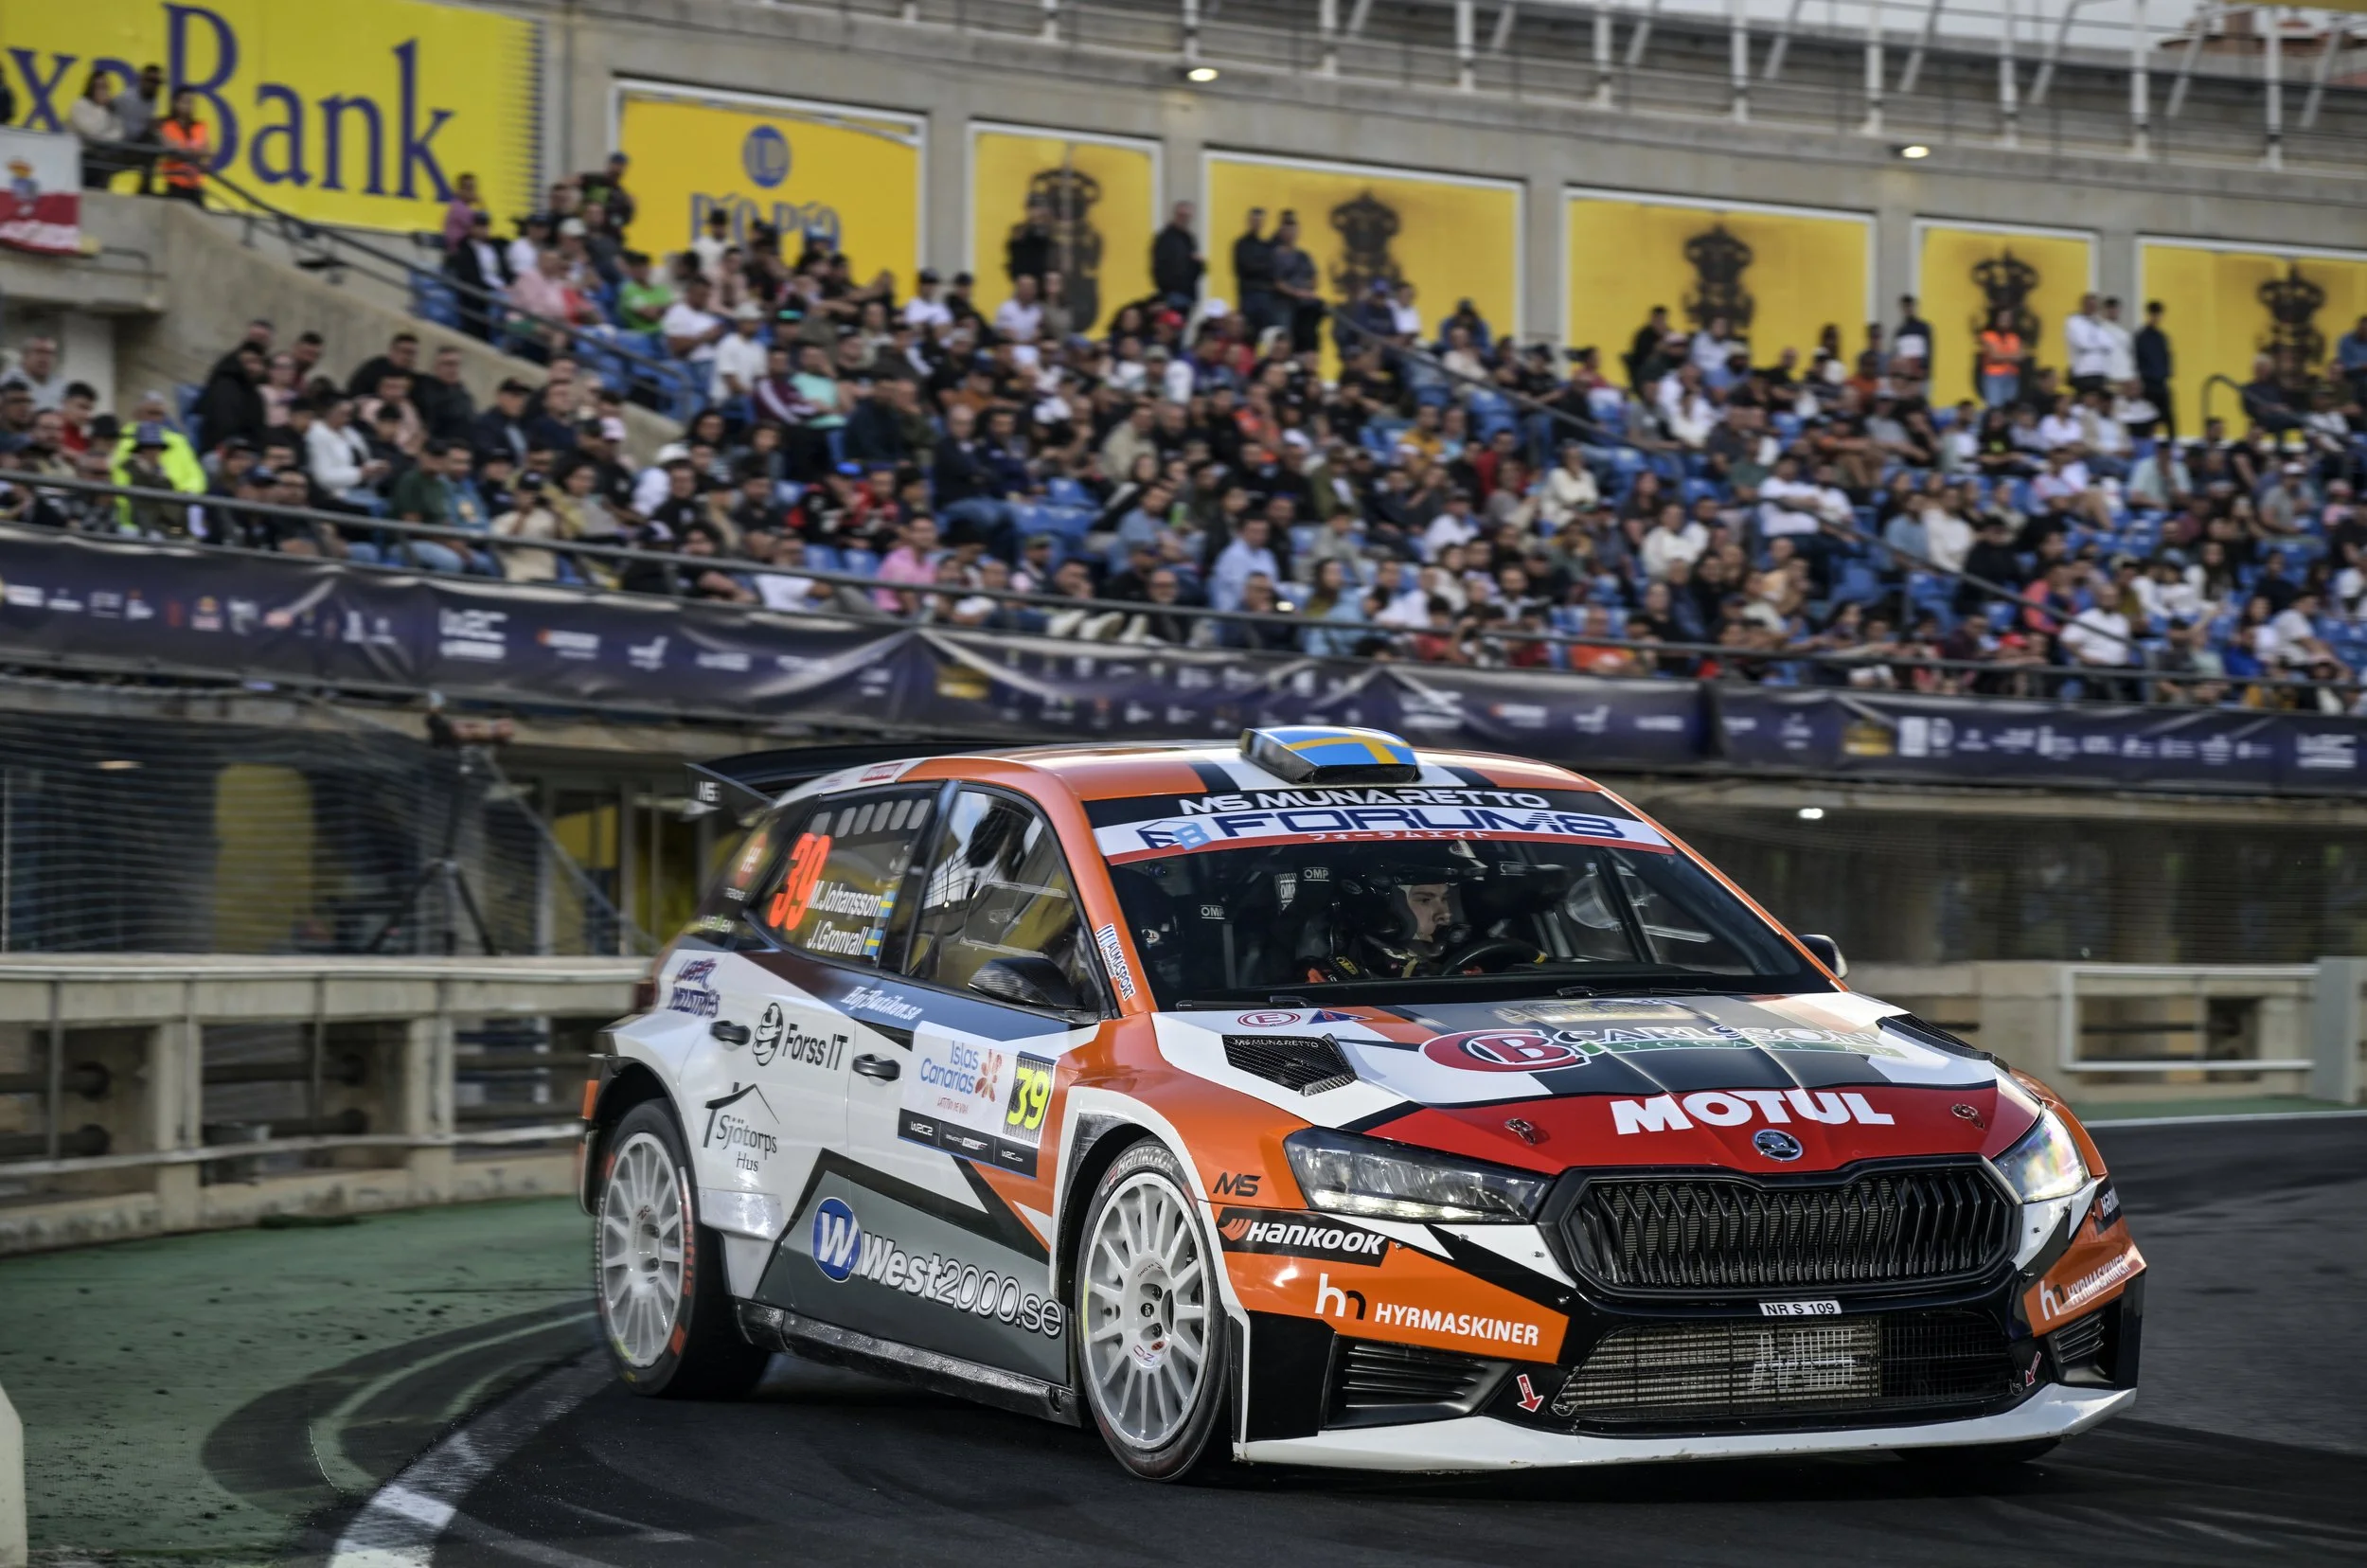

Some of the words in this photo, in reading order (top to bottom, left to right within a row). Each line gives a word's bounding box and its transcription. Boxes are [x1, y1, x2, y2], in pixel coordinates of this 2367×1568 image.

[1180, 794, 1254, 815] MS
[1256, 789, 1551, 810] MUNARETTO
[1211, 808, 1627, 839] FORUM8
[1308, 830, 1491, 841] フォーラムエイト
[768, 832, 832, 932] 39
[1279, 882, 1296, 900] OMP
[1303, 868, 1329, 880] OMP
[806, 879, 882, 918] M.Johansson
[806, 919, 870, 956] J.Gronvall
[781, 1023, 827, 1066] Forss
[826, 1033, 849, 1071] IT
[1553, 1025, 1883, 1047] CARLSSON
[950, 1041, 979, 1071] Islas
[920, 1057, 976, 1095] Canarias
[1006, 1066, 1051, 1131] 39
[1610, 1089, 1895, 1135] MOTUL
[716, 1114, 777, 1161] Sjötorps
[736, 1150, 759, 1172] Hus
[1213, 1171, 1262, 1197] MS
[818, 1211, 860, 1268] W
[859, 1230, 1062, 1338] West2000.se
[2066, 1253, 2131, 1306] HYRMASKINER
[1375, 1302, 1539, 1346] HYRMASKINER
[1765, 1304, 1789, 1315] NR
[1792, 1304, 1805, 1314] S
[1807, 1303, 1835, 1314] 109
